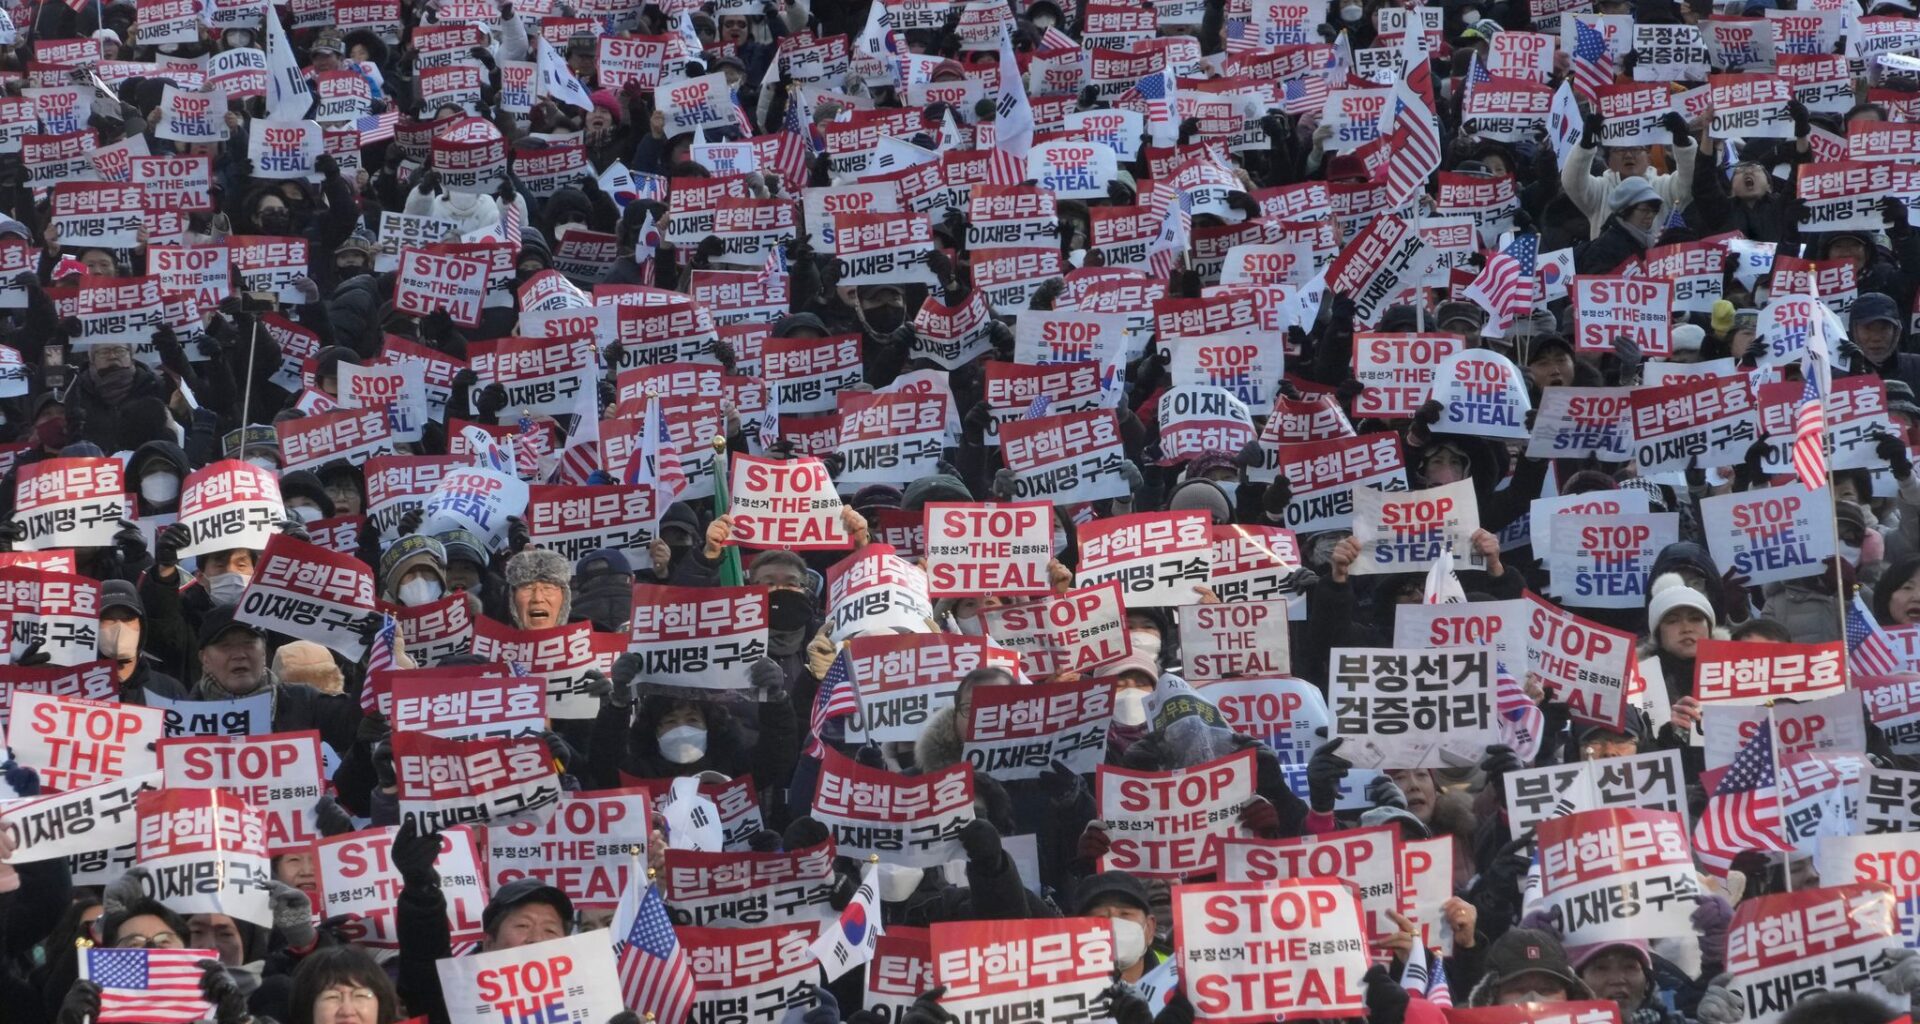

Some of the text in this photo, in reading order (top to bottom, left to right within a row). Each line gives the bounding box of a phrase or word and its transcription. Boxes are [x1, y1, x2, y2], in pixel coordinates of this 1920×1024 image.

[338, 3, 399, 22] 탄핵무효
[1087, 10, 1155, 32] 탄핵무효
[1269, 5, 1308, 19] STOP
[1785, 17, 1823, 30] STOP
[414, 27, 478, 52] 탄핵무효
[1494, 36, 1546, 52] STOP
[1715, 27, 1753, 41] STOP
[1789, 30, 1818, 43] THE
[609, 42, 656, 58] STOP
[1722, 41, 1749, 53] THE
[1093, 52, 1165, 79] 탄핵무효
[1500, 51, 1539, 69] THE
[421, 69, 479, 93] 탄핵무효
[504, 67, 533, 80] STOP
[1045, 68, 1083, 82] STOP
[39, 92, 78, 107] STOP
[508, 80, 528, 94] THE
[671, 82, 709, 104] STOP
[926, 88, 966, 102] STOP
[1713, 79, 1792, 106] 탄핵무효
[172, 95, 210, 111] STOP
[1342, 96, 1386, 112] STOP
[1472, 91, 1552, 113] 탄핵무효
[1601, 86, 1670, 115] 탄핵무효
[45, 107, 74, 121] THE
[674, 110, 723, 128] STEAL
[1349, 112, 1379, 126] THE
[1712, 110, 1758, 132] 이재명
[171, 123, 215, 136] STEAL
[266, 129, 306, 143] STOP
[271, 143, 301, 158] THE
[433, 141, 505, 167] 탄핵무효
[707, 147, 739, 158] STOP
[1046, 148, 1094, 161] STOP
[142, 160, 199, 178] STOP
[261, 157, 311, 172] STEAL
[1053, 161, 1088, 175] THE
[1044, 175, 1100, 191] STEAL
[1440, 178, 1515, 207] 탄핵무효
[1800, 165, 1891, 199] 탄핵무효
[56, 187, 142, 215] 탄핵무효
[823, 191, 874, 212] STOP
[971, 192, 1055, 220] 탄핵무효
[55, 216, 105, 239] 이재명
[668, 213, 713, 236] 이재명
[715, 203, 794, 231] 탄핵무효
[838, 217, 930, 253] 탄핵무효
[968, 224, 1022, 244] 이재명
[158, 249, 218, 271] STOP
[231, 242, 305, 267] 탄핵무효
[840, 254, 894, 278] 이재명
[974, 253, 1059, 281] 탄핵무효
[1244, 253, 1296, 272] STOP
[1649, 249, 1723, 278] 탄핵무효
[174, 275, 201, 285] THE
[414, 256, 477, 282] STOP
[79, 279, 162, 310] 탄핵무효
[431, 281, 458, 296] THE
[1590, 281, 1658, 306] STOP
[545, 316, 598, 337] STOP
[1158, 297, 1256, 337] 탄핵무효
[1612, 308, 1639, 323] THE
[1043, 321, 1101, 341] STOP
[497, 339, 593, 381] 탄핵무효
[765, 339, 859, 379] 탄핵무효
[1049, 342, 1093, 361] THE
[1198, 345, 1259, 367] STOP
[1370, 339, 1454, 364] STOP
[1207, 366, 1249, 386] THE
[1393, 368, 1432, 383] THE
[1455, 360, 1511, 381] STOP
[1465, 381, 1506, 402] THE
[1449, 402, 1521, 427] STEAL
[1567, 396, 1630, 418] STOP
[1637, 381, 1750, 435] 탄핵무효
[842, 400, 943, 440] 탄핵무효
[283, 411, 388, 461] 탄핵무효
[1005, 414, 1118, 470] 탄핵무효
[1553, 430, 1626, 455] STEAL
[1639, 418, 1753, 468] 이재명 구속
[902, 437, 942, 462] 구속
[746, 463, 826, 492] STOP
[1284, 438, 1400, 493] 탄핵무효
[17, 463, 123, 505] 탄핵무효
[181, 470, 283, 515] 탄핵무효
[533, 490, 656, 533] 탄핵무효
[769, 497, 811, 514] THE
[1383, 497, 1453, 524] STOP
[1733, 497, 1801, 528] STOP
[17, 508, 76, 539] 이재명
[732, 516, 843, 542] STEAL
[943, 510, 1037, 539] STOP
[1393, 524, 1444, 544] THE
[1745, 522, 1794, 547] THE
[1081, 516, 1207, 571] 탄핵무효
[1582, 526, 1650, 549] STOP
[931, 542, 1048, 559] 부정선거 THE 검증하라
[1590, 549, 1641, 573] THE
[1734, 542, 1816, 574] STEAL
[260, 554, 376, 609] 탄핵무효
[932, 563, 1045, 590] STEAL
[243, 591, 323, 626] 이재명
[634, 594, 763, 641] 탄핵무효
[1003, 594, 1102, 630] STOP
[1197, 605, 1267, 629] STOP
[1212, 631, 1256, 650] THE
[1430, 615, 1502, 645] STOP
[1529, 607, 1612, 662] STOP
[1194, 651, 1278, 677] STEAL
[1336, 651, 1488, 693] 부정선거
[1541, 650, 1579, 681] THE
[1700, 649, 1840, 697] 탄핵무효
[397, 683, 539, 732] 탄핵무효
[974, 682, 1112, 739] 탄핵무효
[1218, 692, 1302, 723] STOP
[1336, 693, 1490, 735] 검증하라
[32, 702, 142, 744] STOP
[43, 738, 125, 775] THE
[185, 743, 298, 782] STOP
[401, 742, 549, 797] 탄핵무효
[270, 786, 319, 801] 검증하라
[817, 771, 968, 819] 탄핵무효
[1120, 767, 1234, 811] STOP
[140, 803, 266, 860] 탄핵무효
[1154, 811, 1207, 835] THE
[493, 841, 595, 861] 부정선거 THE
[1544, 820, 1688, 890] 탄핵무효
[141, 861, 224, 901] 이재명
[672, 847, 835, 899] 탄핵무효
[328, 886, 375, 903] 부정선거
[1204, 890, 1337, 934] STOP
[939, 926, 1114, 999] 탄핵무효
[1189, 938, 1361, 964] 부정선거 THE 검증하라
[477, 955, 573, 1001] STOP
[1195, 967, 1363, 1013] STEAL
